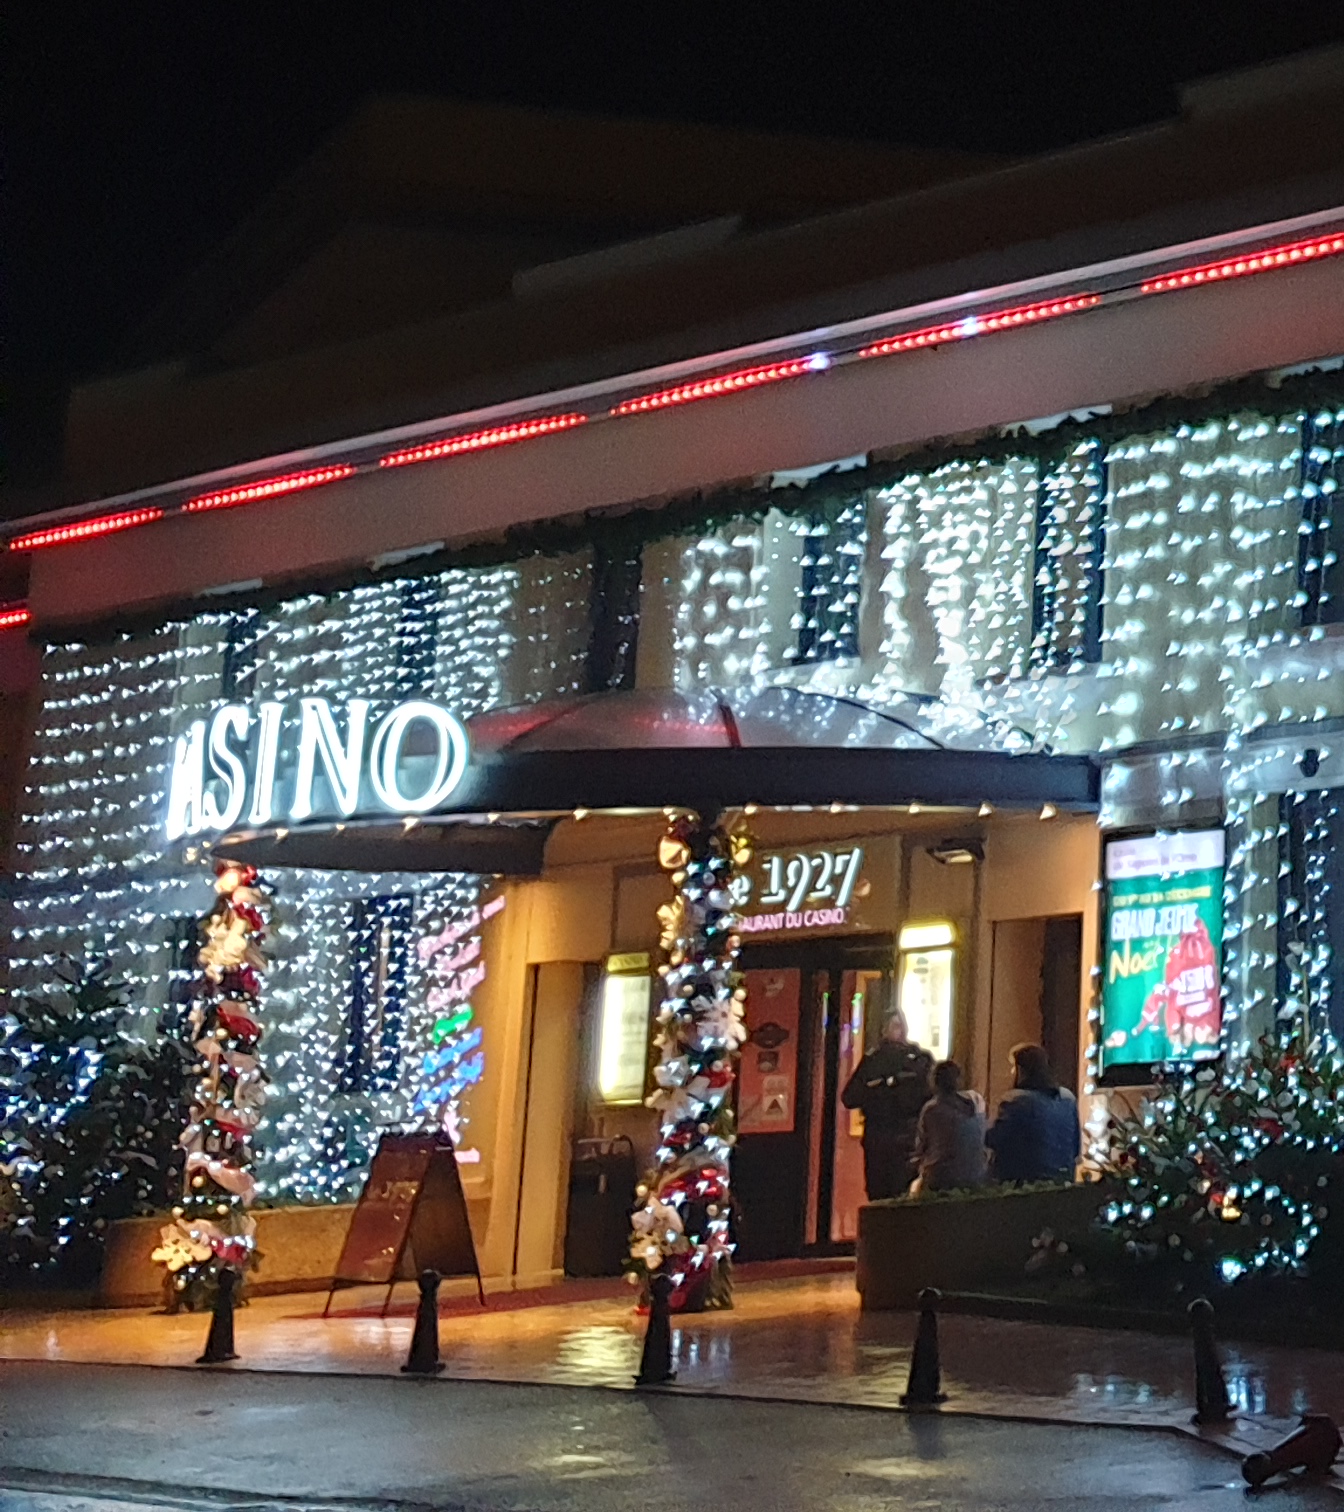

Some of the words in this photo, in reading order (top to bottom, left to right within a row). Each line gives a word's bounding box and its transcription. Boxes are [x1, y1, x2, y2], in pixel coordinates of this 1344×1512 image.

[729, 874, 749, 906] e
[760, 848, 863, 912] 1927
[739, 911, 785, 932] AURANT
[785, 911, 803, 929] DU
[804, 907, 845, 927] CASINO
